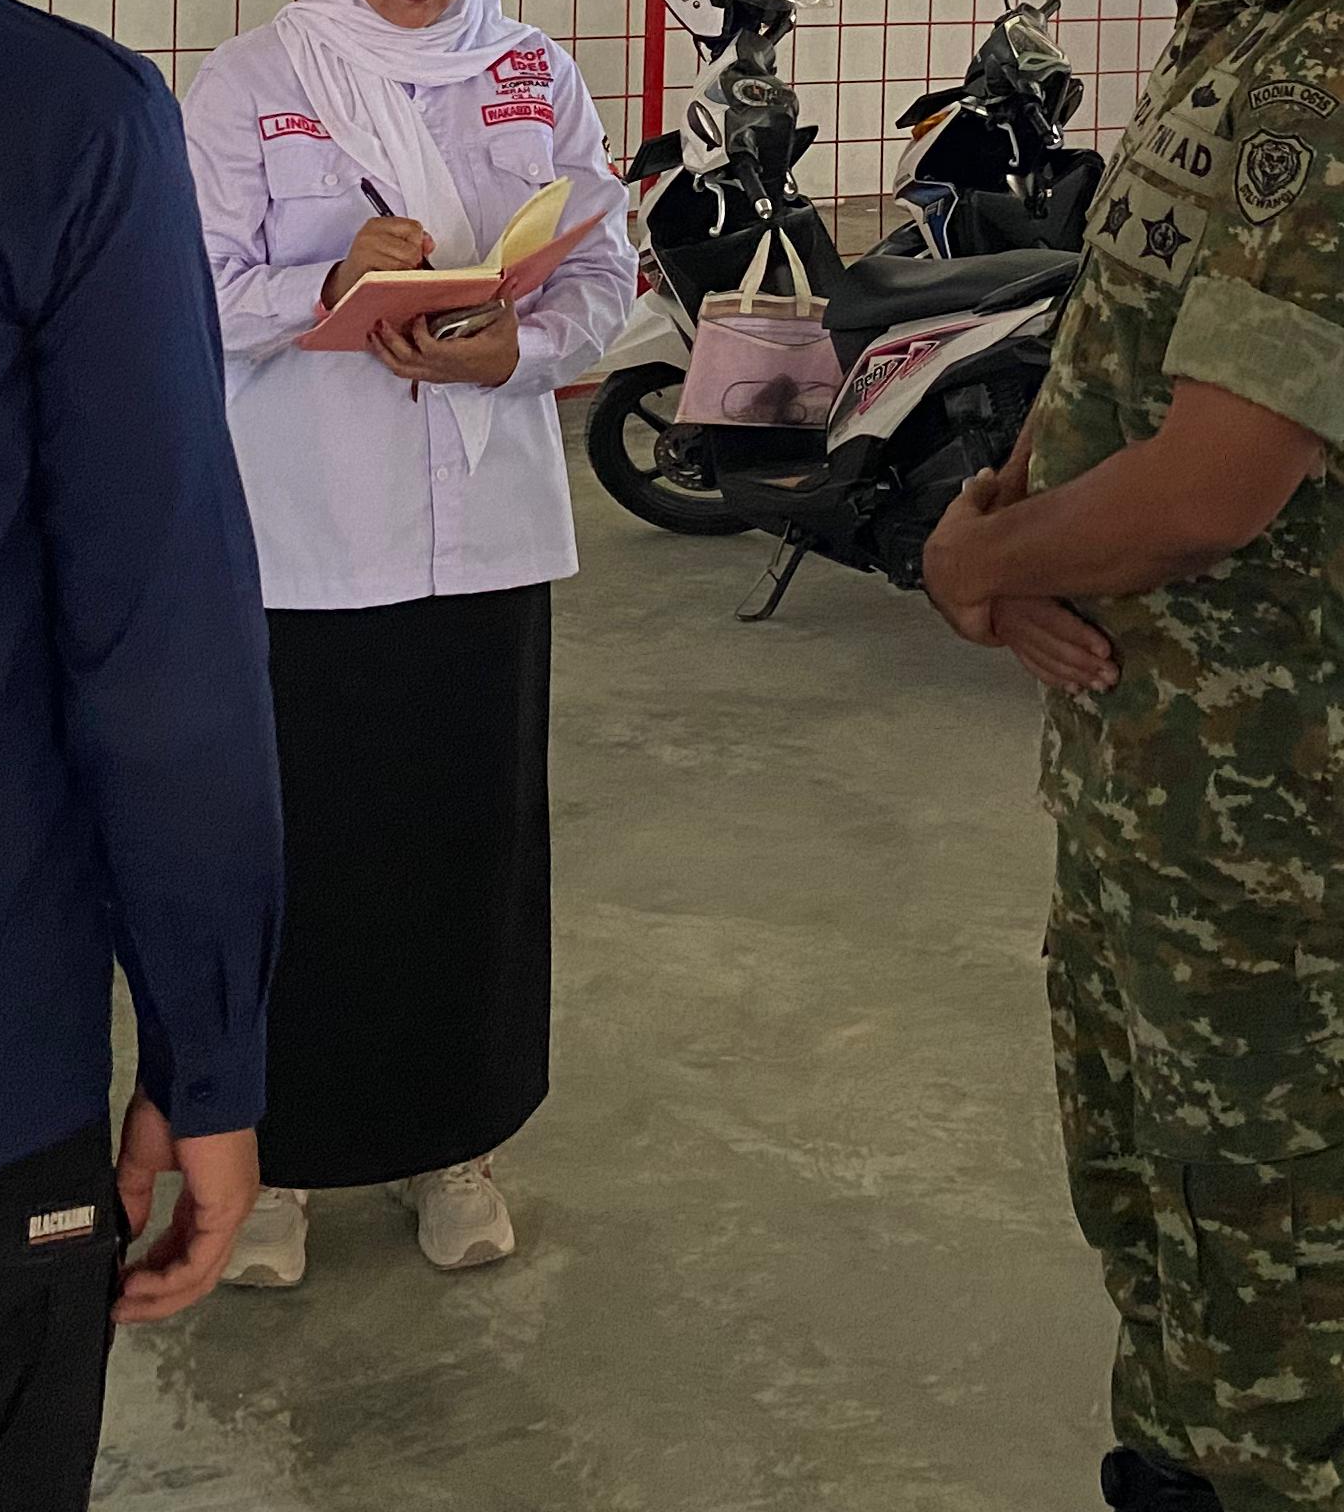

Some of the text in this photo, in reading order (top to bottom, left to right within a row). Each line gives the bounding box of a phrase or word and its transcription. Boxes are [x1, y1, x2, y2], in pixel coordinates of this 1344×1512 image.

[1252, 85, 1296, 105] KODIM
[274, 117, 322, 135] LINDA
[1168, 137, 1213, 178] AD
